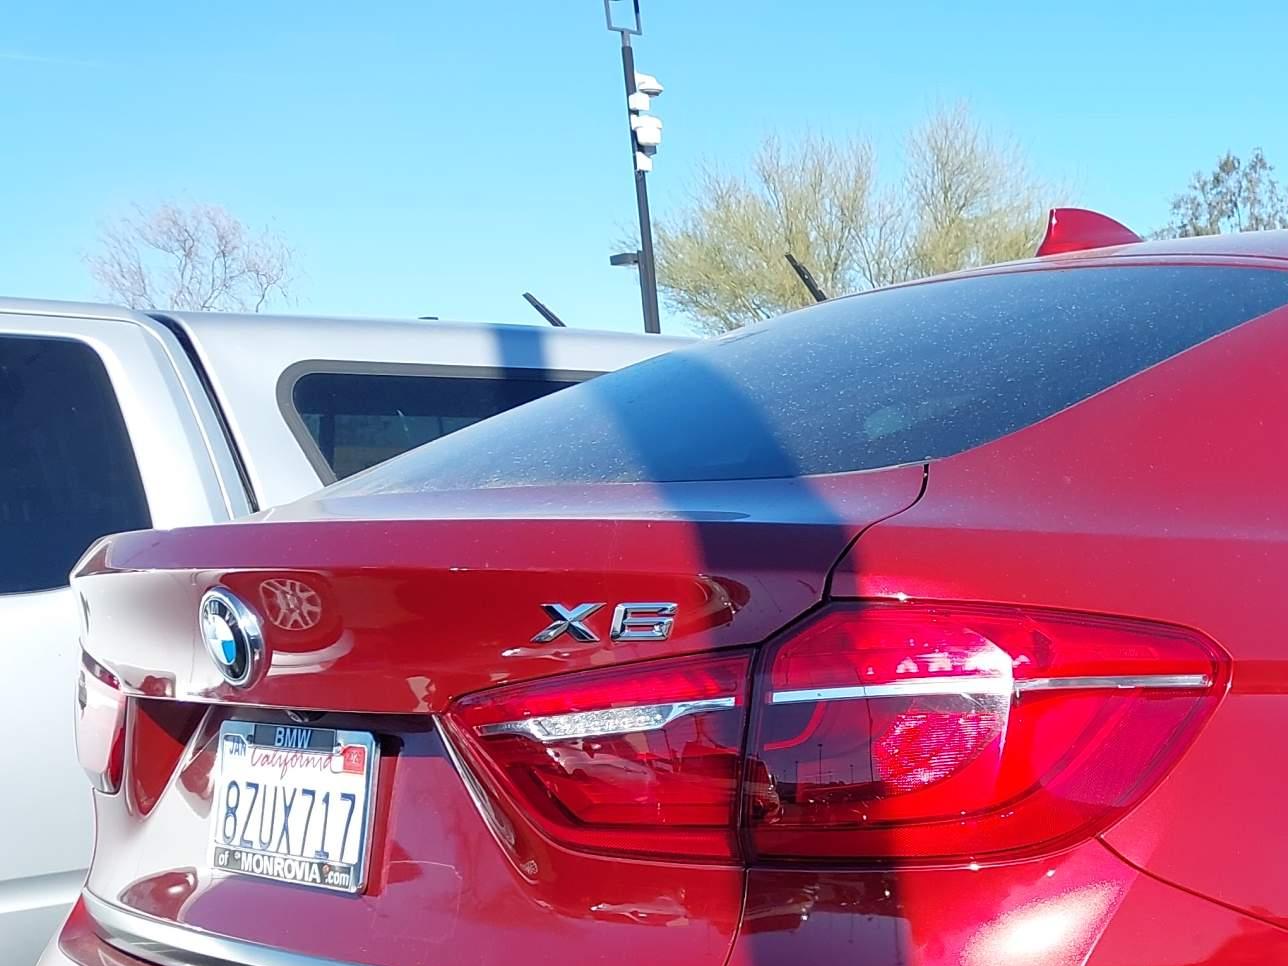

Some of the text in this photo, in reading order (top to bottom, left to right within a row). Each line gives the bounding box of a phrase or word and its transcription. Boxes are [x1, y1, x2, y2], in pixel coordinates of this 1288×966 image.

[530, 602, 678, 641] X6
[275, 727, 312, 750] BMW
[229, 740, 246, 756] JAN
[250, 747, 333, 781] California
[222, 780, 356, 862] 8ZUX717
[218, 851, 350, 887] of MONROVIA .com
